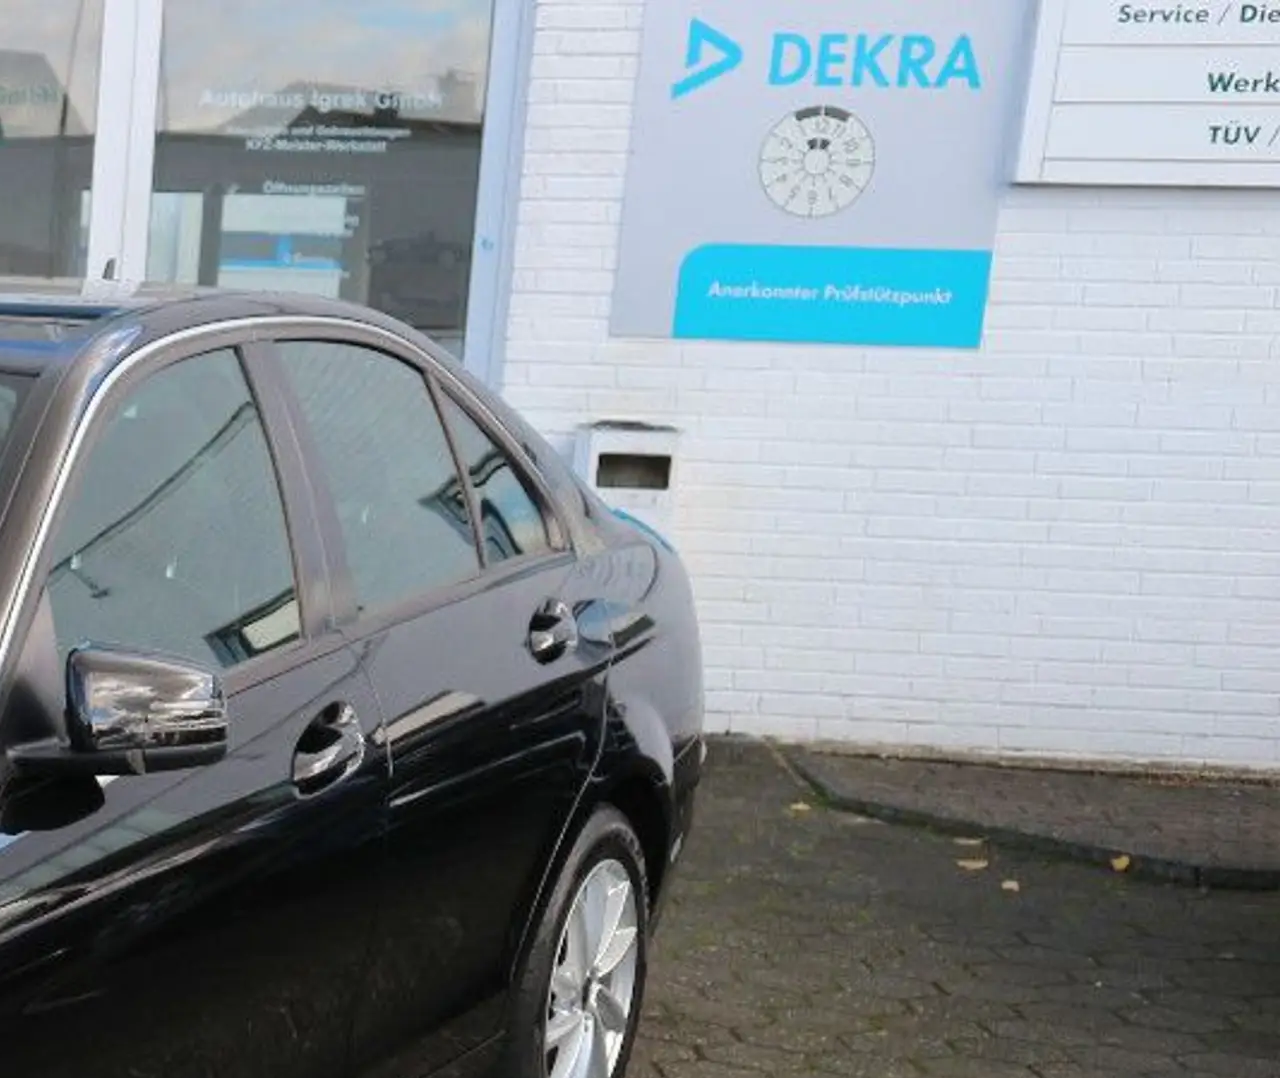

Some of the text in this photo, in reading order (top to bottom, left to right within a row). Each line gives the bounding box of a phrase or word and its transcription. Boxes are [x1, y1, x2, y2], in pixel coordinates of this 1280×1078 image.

[1118, 4, 1209, 23] Service
[768, 33, 980, 89] DEKRA
[1209, 120, 1261, 144] TÜV
[708, 281, 954, 306] Anerkannter Prüfstützpunkt
